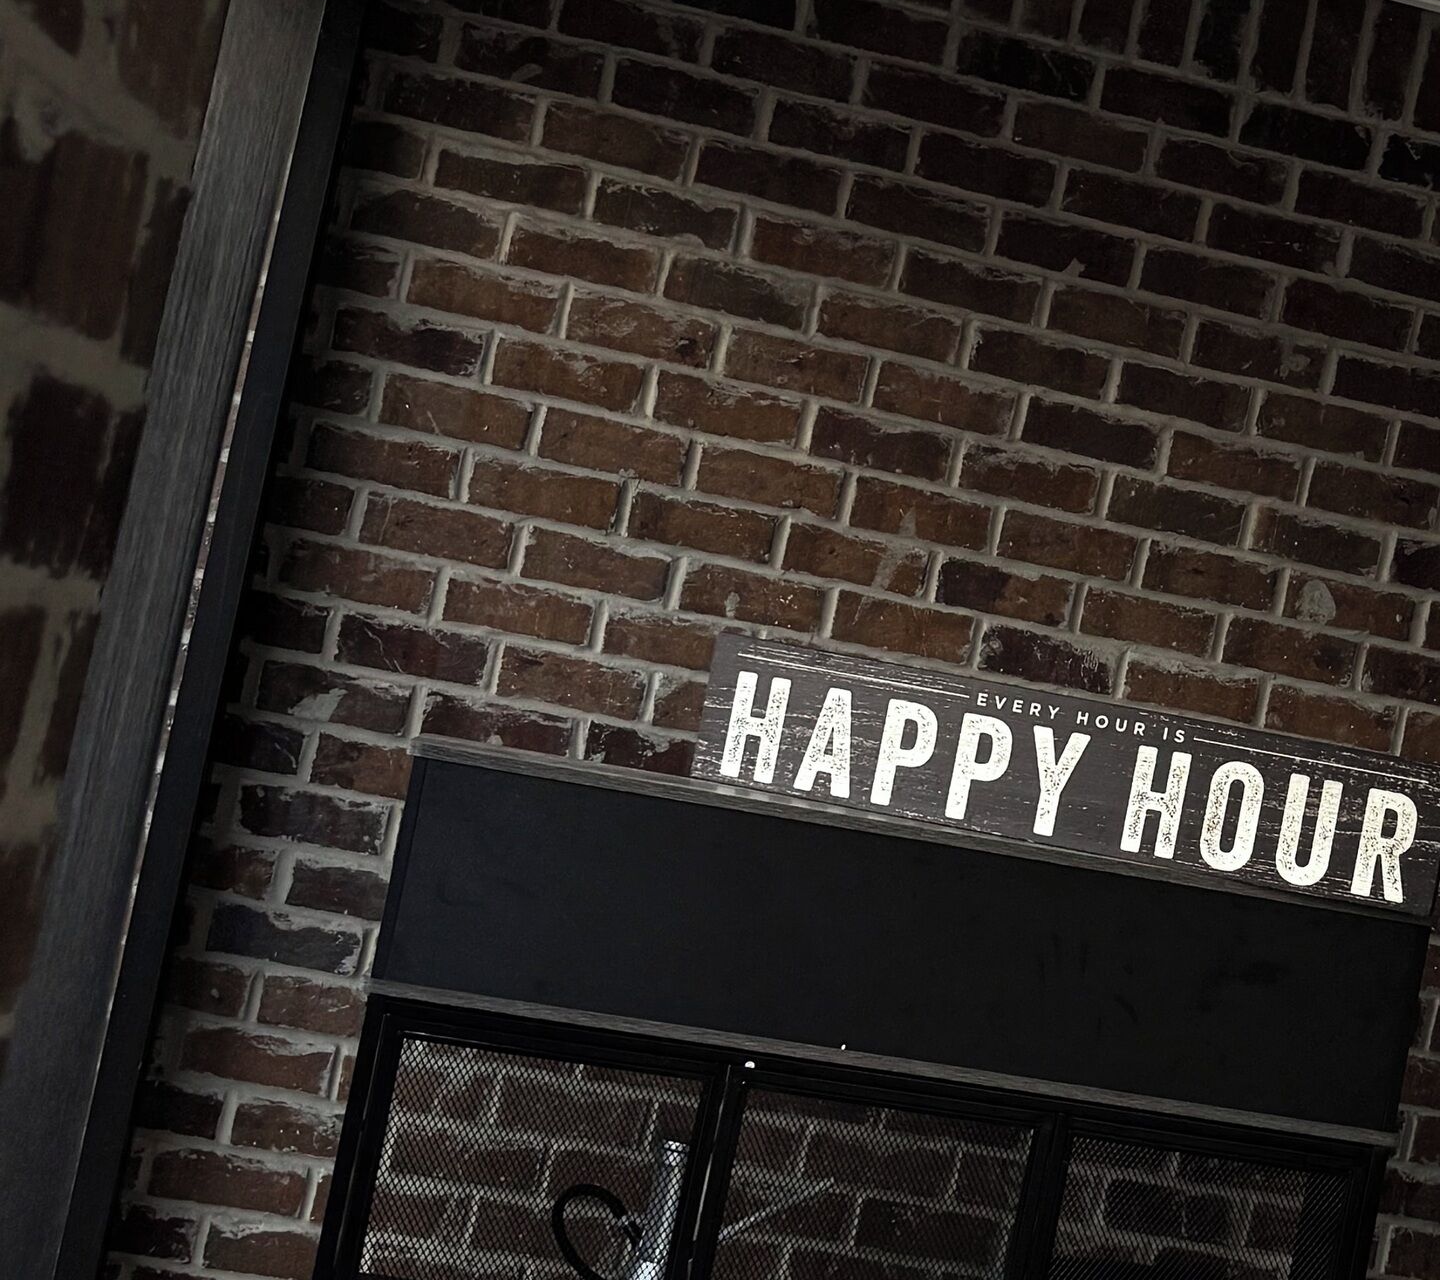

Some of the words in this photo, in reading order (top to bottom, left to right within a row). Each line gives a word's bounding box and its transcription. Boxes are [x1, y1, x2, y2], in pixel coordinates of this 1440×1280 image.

[719, 670, 1092, 837] HAPPY
[1120, 744, 1419, 904] HOUR
[976, 692, 1060, 720] EVERY
[1076, 710, 1146, 737] HOUR
[1162, 726, 1186, 743] IS
